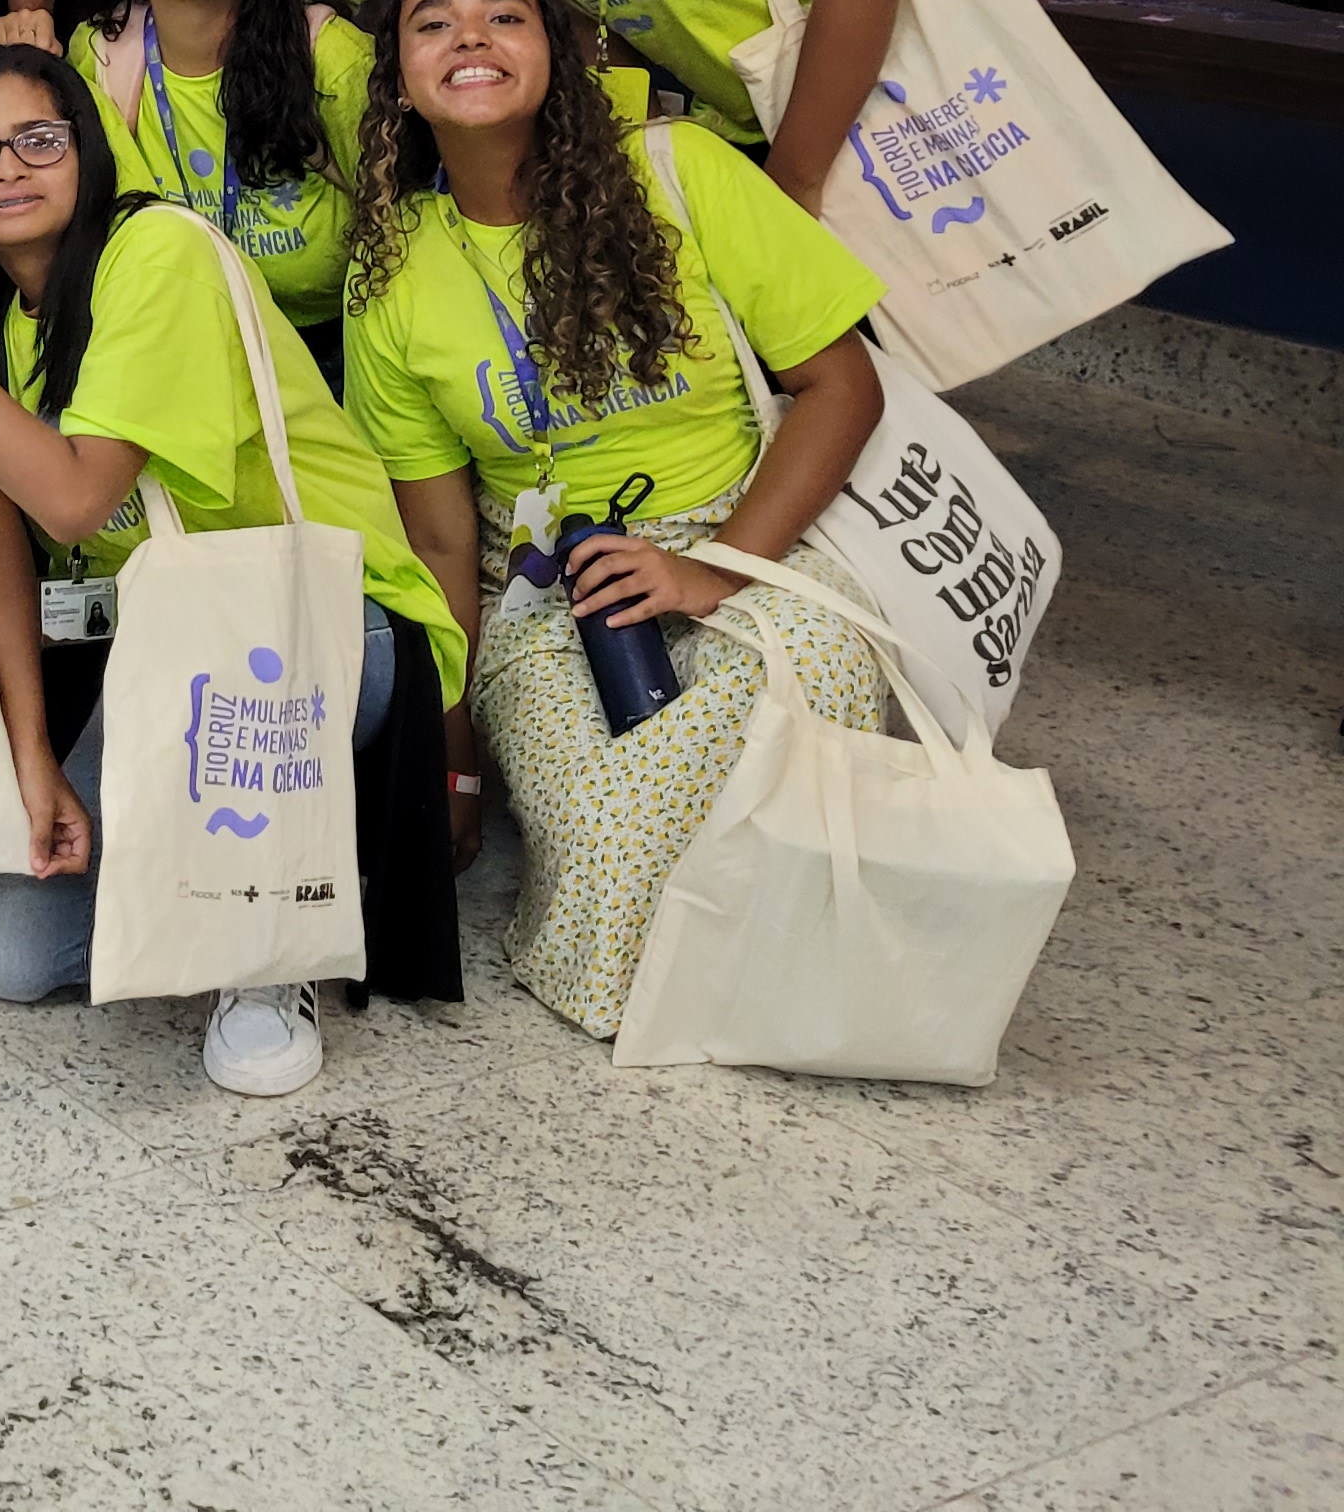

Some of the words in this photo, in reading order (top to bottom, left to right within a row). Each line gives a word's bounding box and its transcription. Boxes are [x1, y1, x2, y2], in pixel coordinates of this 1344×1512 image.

[870, 124, 929, 202] FIOCRUZ
[909, 141, 926, 162] E
[923, 159, 962, 191] NA
[1048, 202, 1110, 241] BRASIL
[841, 442, 942, 530] Lute
[204, 692, 237, 786] FIOCRUZ
[236, 726, 249, 749] E
[231, 758, 263, 792] NA
[272, 753, 323, 794] CIÊNCIA
[295, 882, 336, 902] BRASIL
